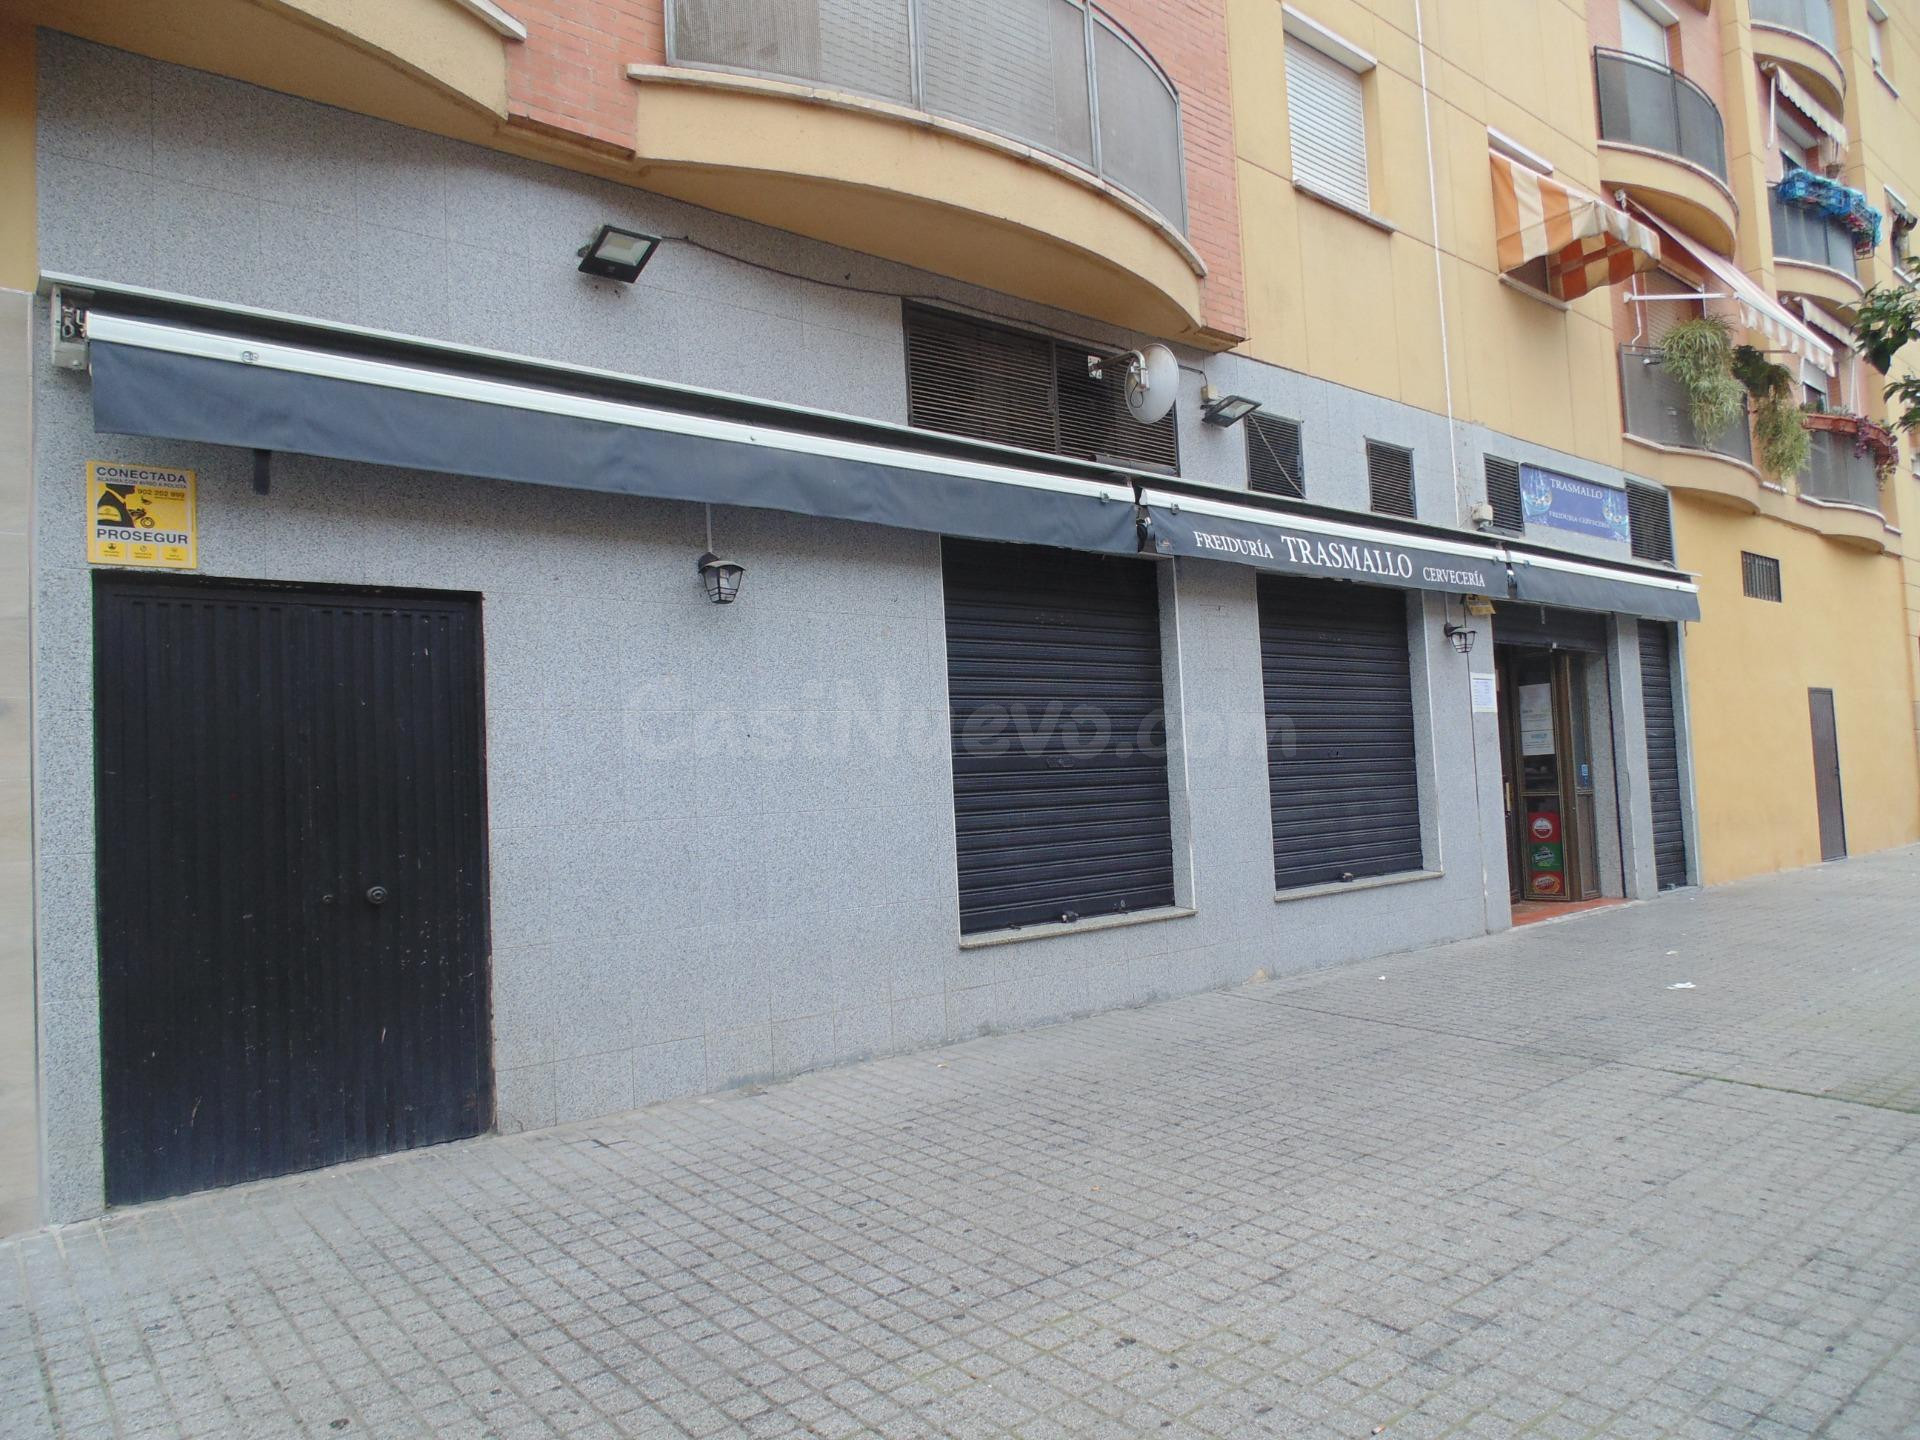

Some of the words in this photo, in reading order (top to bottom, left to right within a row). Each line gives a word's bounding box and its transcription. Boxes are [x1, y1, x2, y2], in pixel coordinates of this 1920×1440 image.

[97, 467, 187, 483] CONECTADA
[1551, 479, 1603, 499] TRASMALLO
[97, 528, 188, 544] PROSEGUR
[1193, 531, 1274, 559] FREIDURÍA
[1280, 535, 1413, 578] TRASMALLO
[1422, 566, 1486, 587] CERVECERÍA
